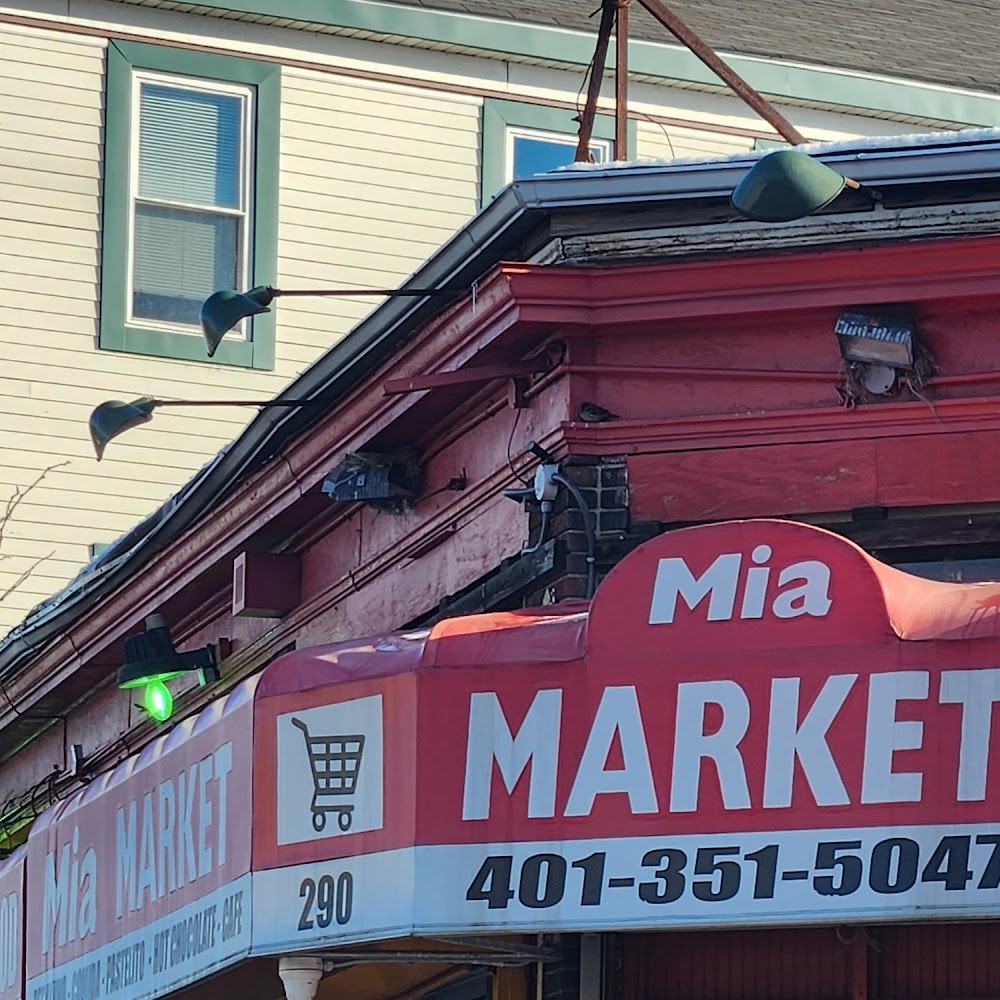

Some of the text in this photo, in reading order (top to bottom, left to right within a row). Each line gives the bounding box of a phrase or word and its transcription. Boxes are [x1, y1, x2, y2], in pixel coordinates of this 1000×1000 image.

[649, 545, 832, 624] Mia
[42, 741, 234, 954] Mia MARKET
[298, 871, 353, 931] 290
[106, 940, 145, 995] PASTELITO
